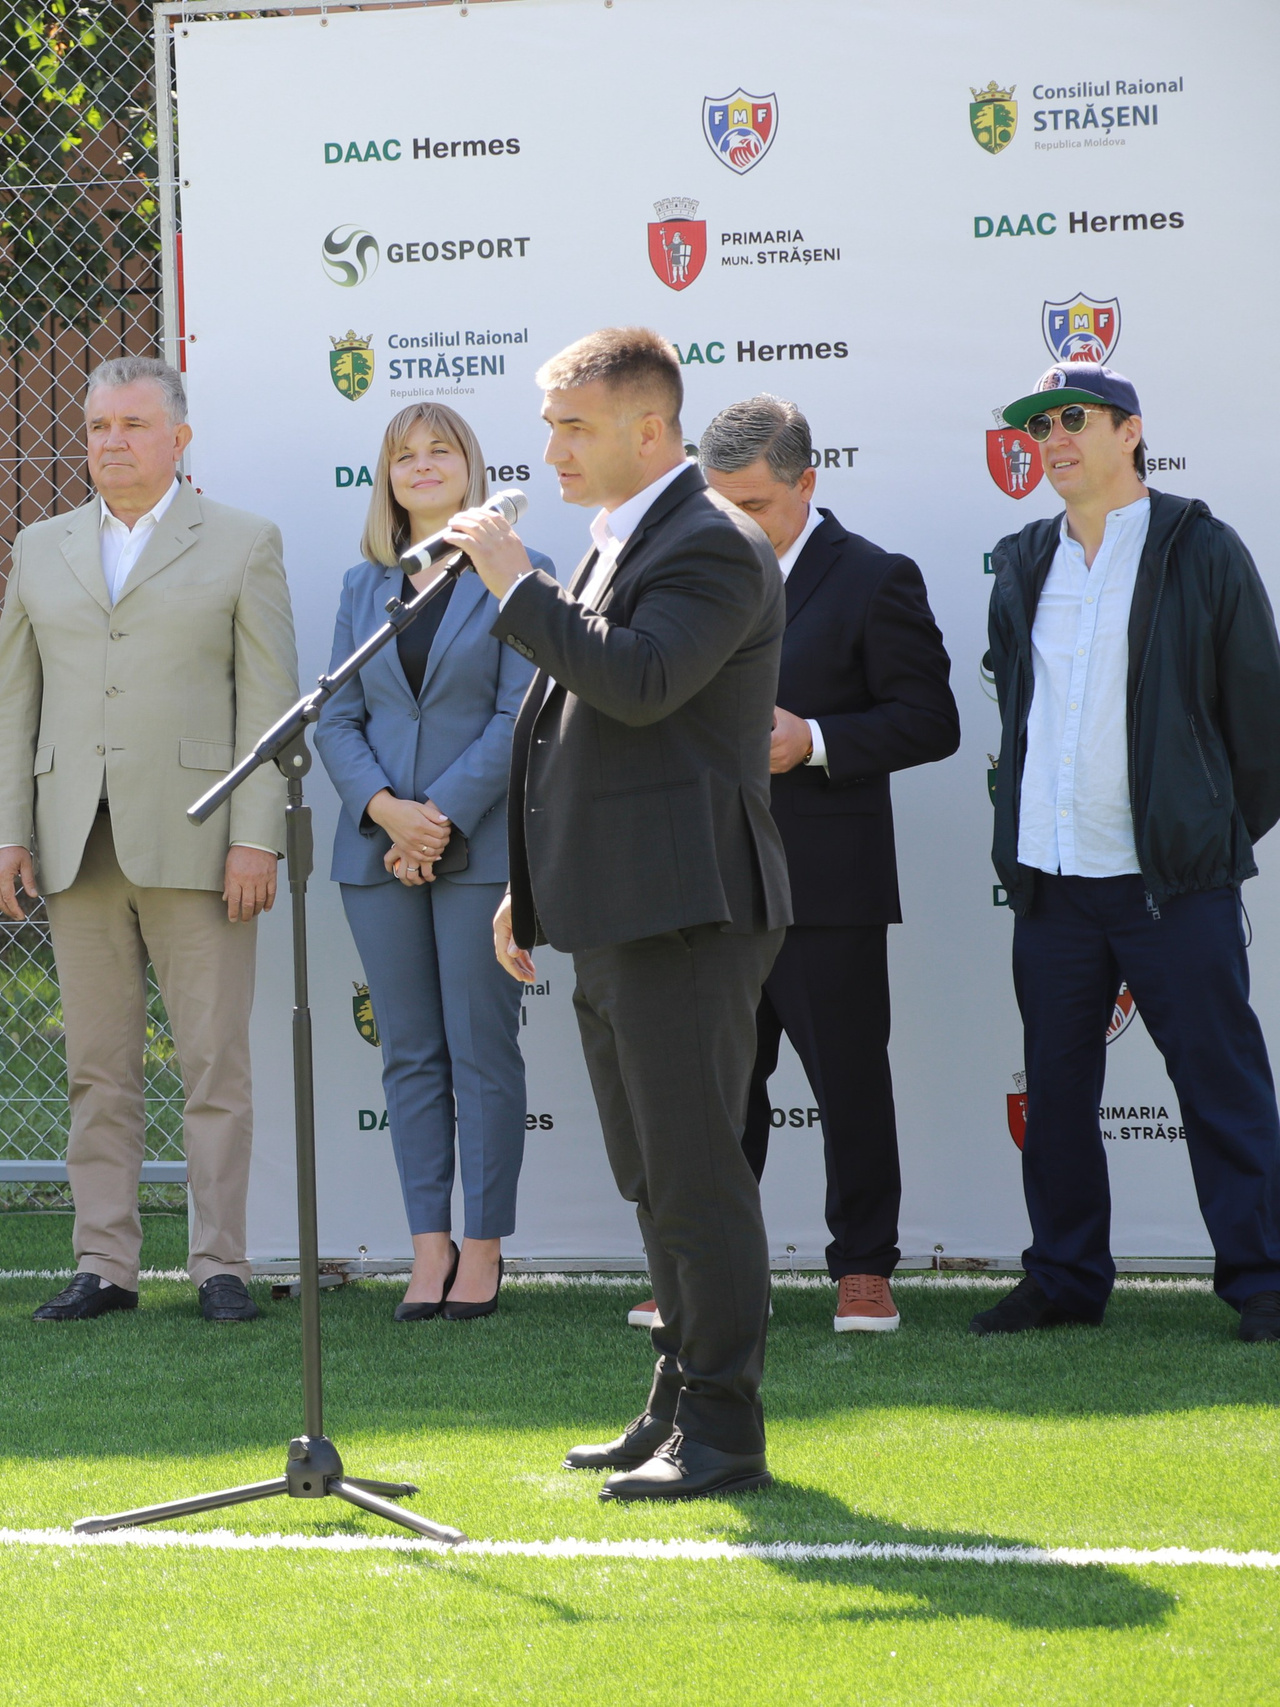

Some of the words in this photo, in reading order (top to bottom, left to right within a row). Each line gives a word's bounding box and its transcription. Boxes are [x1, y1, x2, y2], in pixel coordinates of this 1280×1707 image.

[1033, 84, 1110, 100] Consiliul
[1116, 76, 1184, 95] Raional
[1033, 103, 1158, 135] STRĂȘENI
[324, 139, 402, 164] DAAC
[413, 137, 521, 160] Hermes
[1034, 139, 1081, 151] Republica
[1084, 137, 1126, 148] Moldova
[974, 212, 1057, 238] DAAC
[1069, 211, 1185, 234] Hermes
[721, 229, 804, 246] PRIMARIA
[387, 237, 531, 263] GEOSPORT
[721, 256, 753, 266] MUN.
[757, 246, 841, 266] STRĂȘENI
[388, 331, 460, 349] Consiliul
[465, 328, 528, 346] Raional
[737, 340, 849, 362] Hermes
[389, 353, 505, 384] STRĂȘENI
[390, 388, 434, 399] Republica
[436, 386, 475, 396] Moldova
[335, 465, 374, 488] DA
[1147, 457, 1186, 475] ȘENI
[1098, 1106, 1169, 1120] RIMARIA
[1120, 1123, 1187, 1143] STRĂȘE
